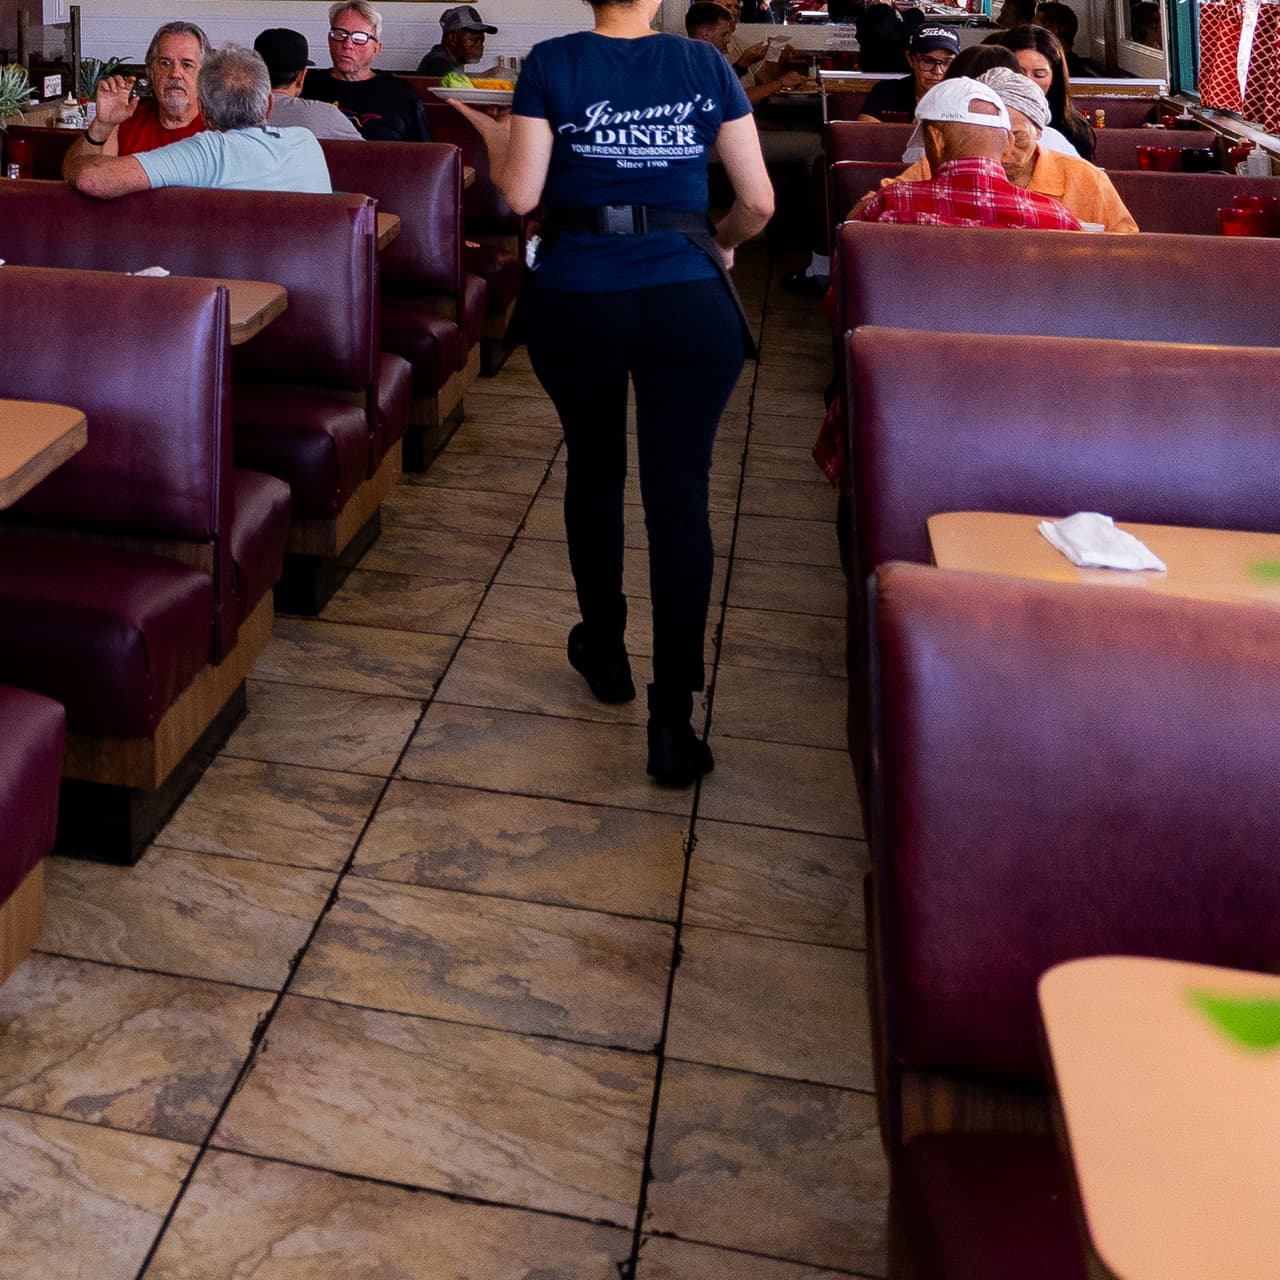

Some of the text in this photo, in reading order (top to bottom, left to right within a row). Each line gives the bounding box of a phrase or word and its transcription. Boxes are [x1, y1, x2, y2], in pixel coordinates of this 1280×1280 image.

[557, 93, 716, 135] Jimmy's
[595, 129, 697, 146] DINER
[571, 143, 591, 153] YOUR
[592, 144, 626, 155] FRIENDLY
[628, 145, 683, 156] NEIGHBORHOOD
[616, 159, 668, 168] Since 1968
